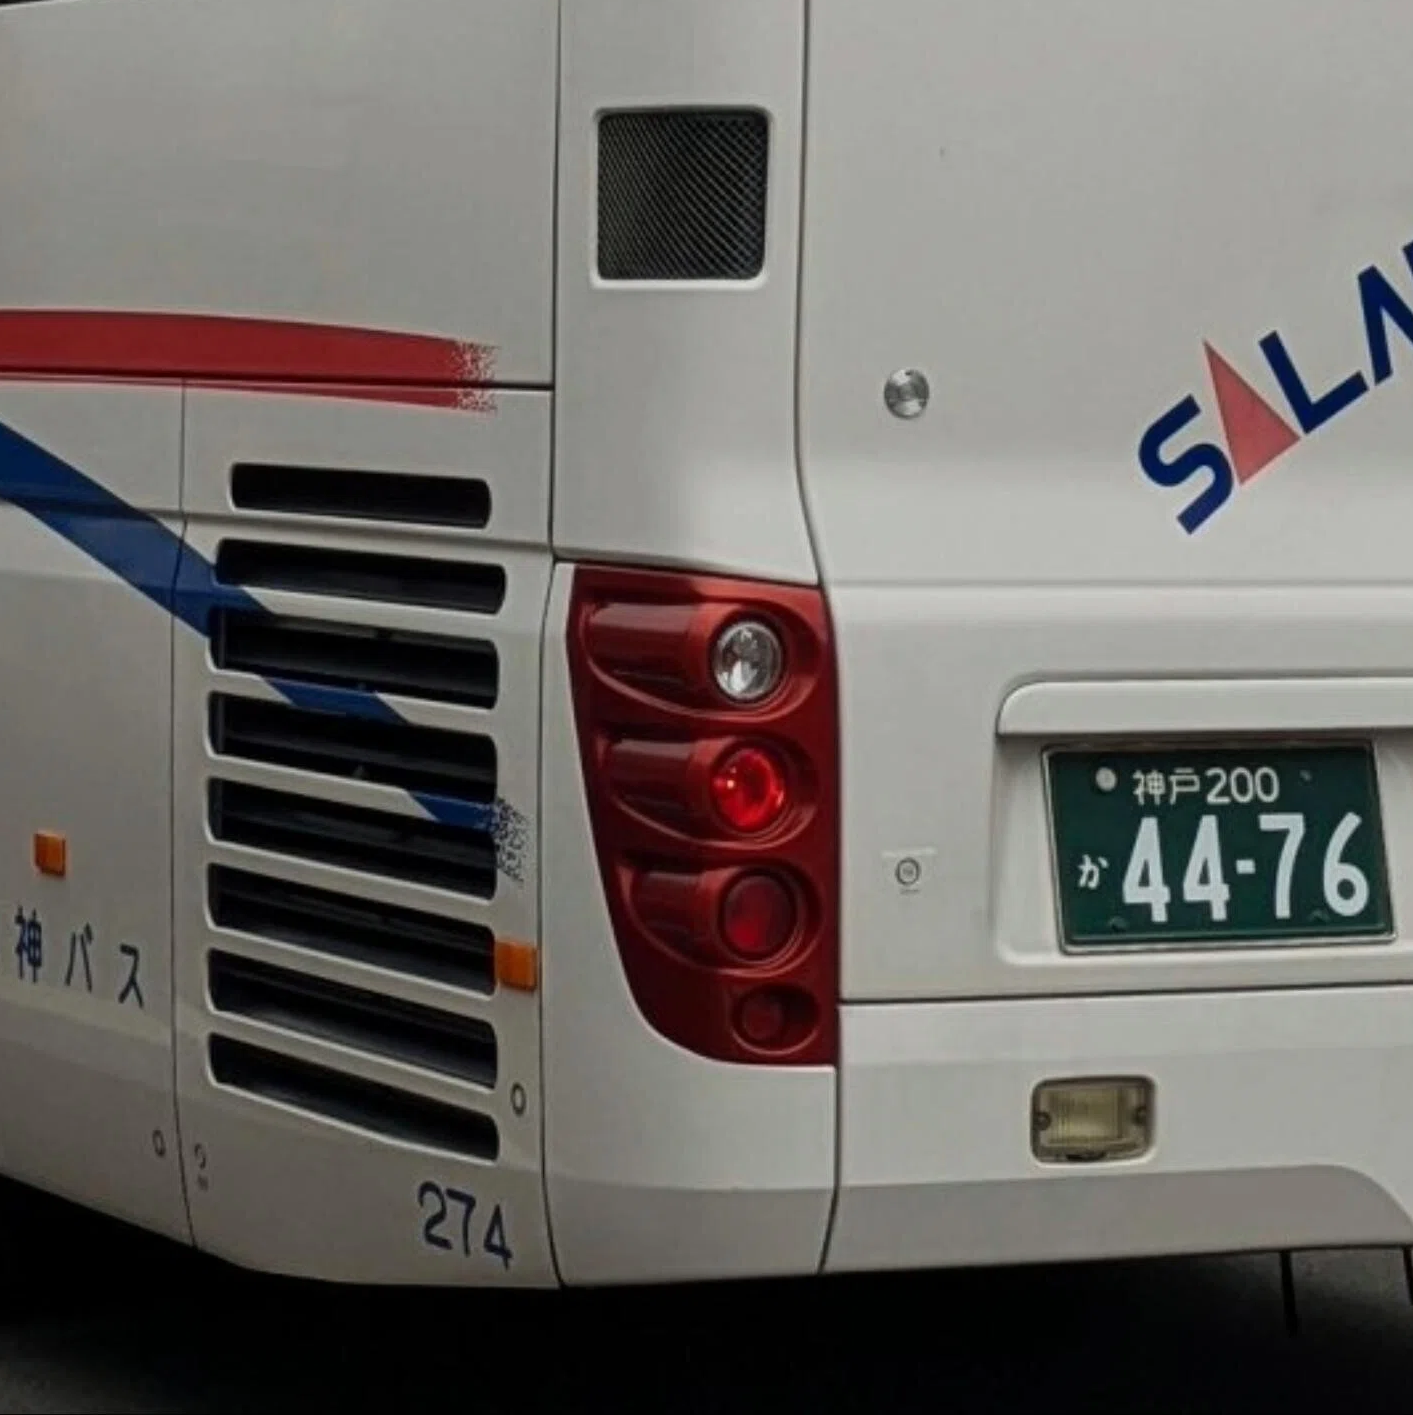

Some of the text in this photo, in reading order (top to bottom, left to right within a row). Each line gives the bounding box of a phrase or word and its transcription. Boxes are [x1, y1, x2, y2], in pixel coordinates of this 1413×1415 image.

[1078, 812, 1369, 922] か 44-76
[417, 1181, 512, 1268] 274
